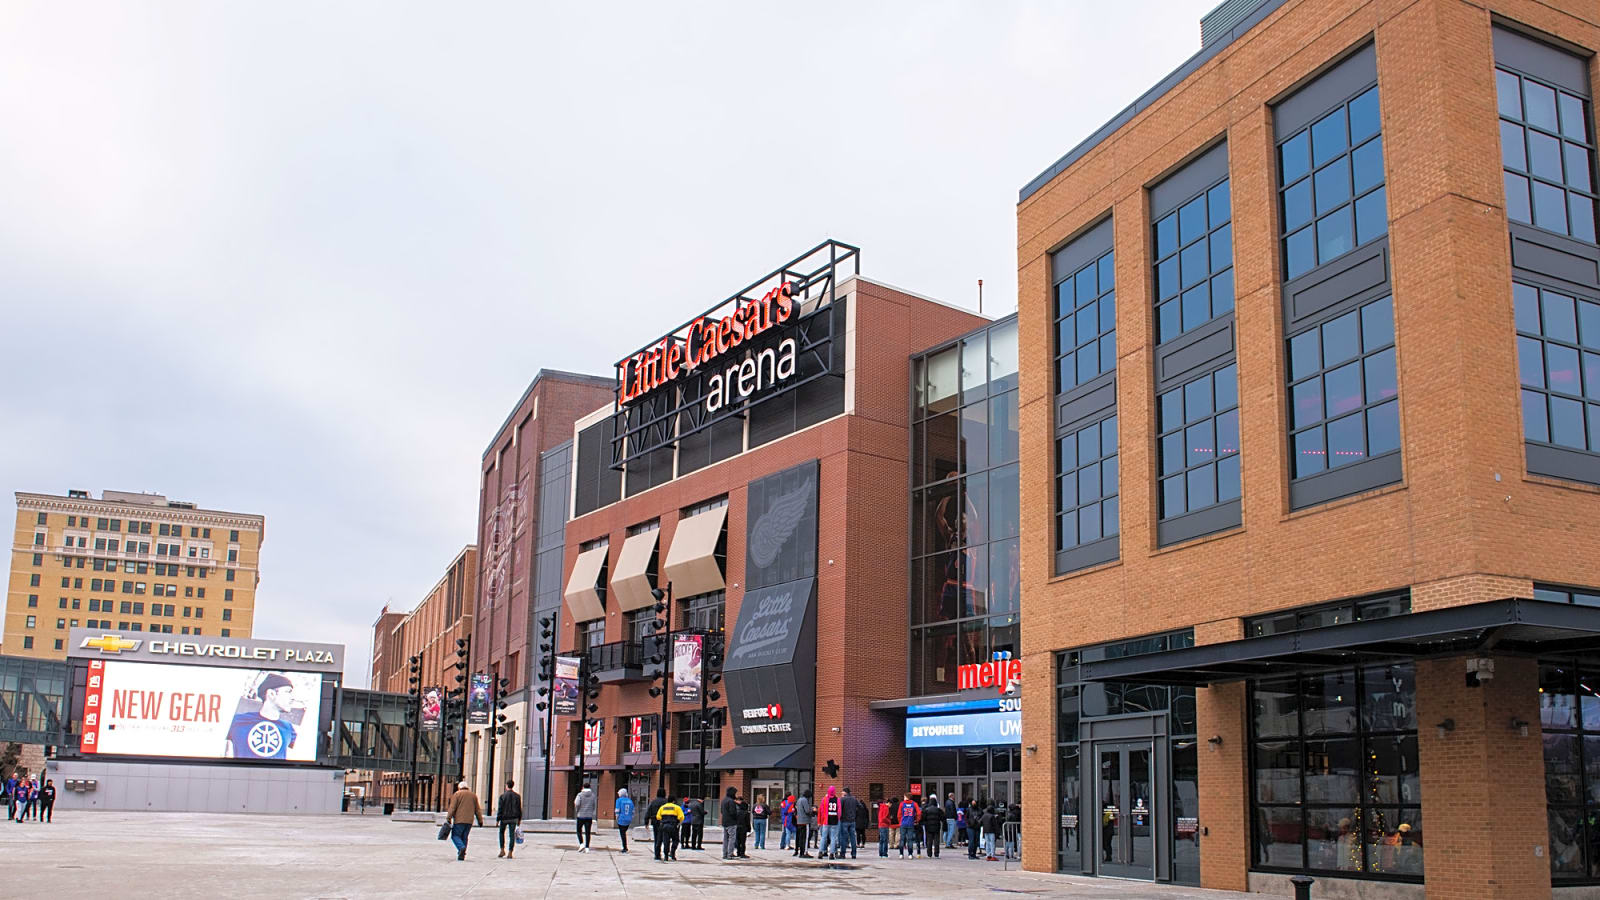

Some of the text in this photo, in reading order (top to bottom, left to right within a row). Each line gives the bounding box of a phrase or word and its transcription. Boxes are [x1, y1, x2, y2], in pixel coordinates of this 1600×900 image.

[619, 280, 794, 405] Little Caesars
[706, 337, 796, 413] arena
[149, 640, 335, 664] CHEVROLET PLAZA
[112, 689, 163, 720] NEW
[169, 692, 222, 723] GEAR
[768, 722, 792, 733] CENTER
[828, 802, 837, 811] 33
